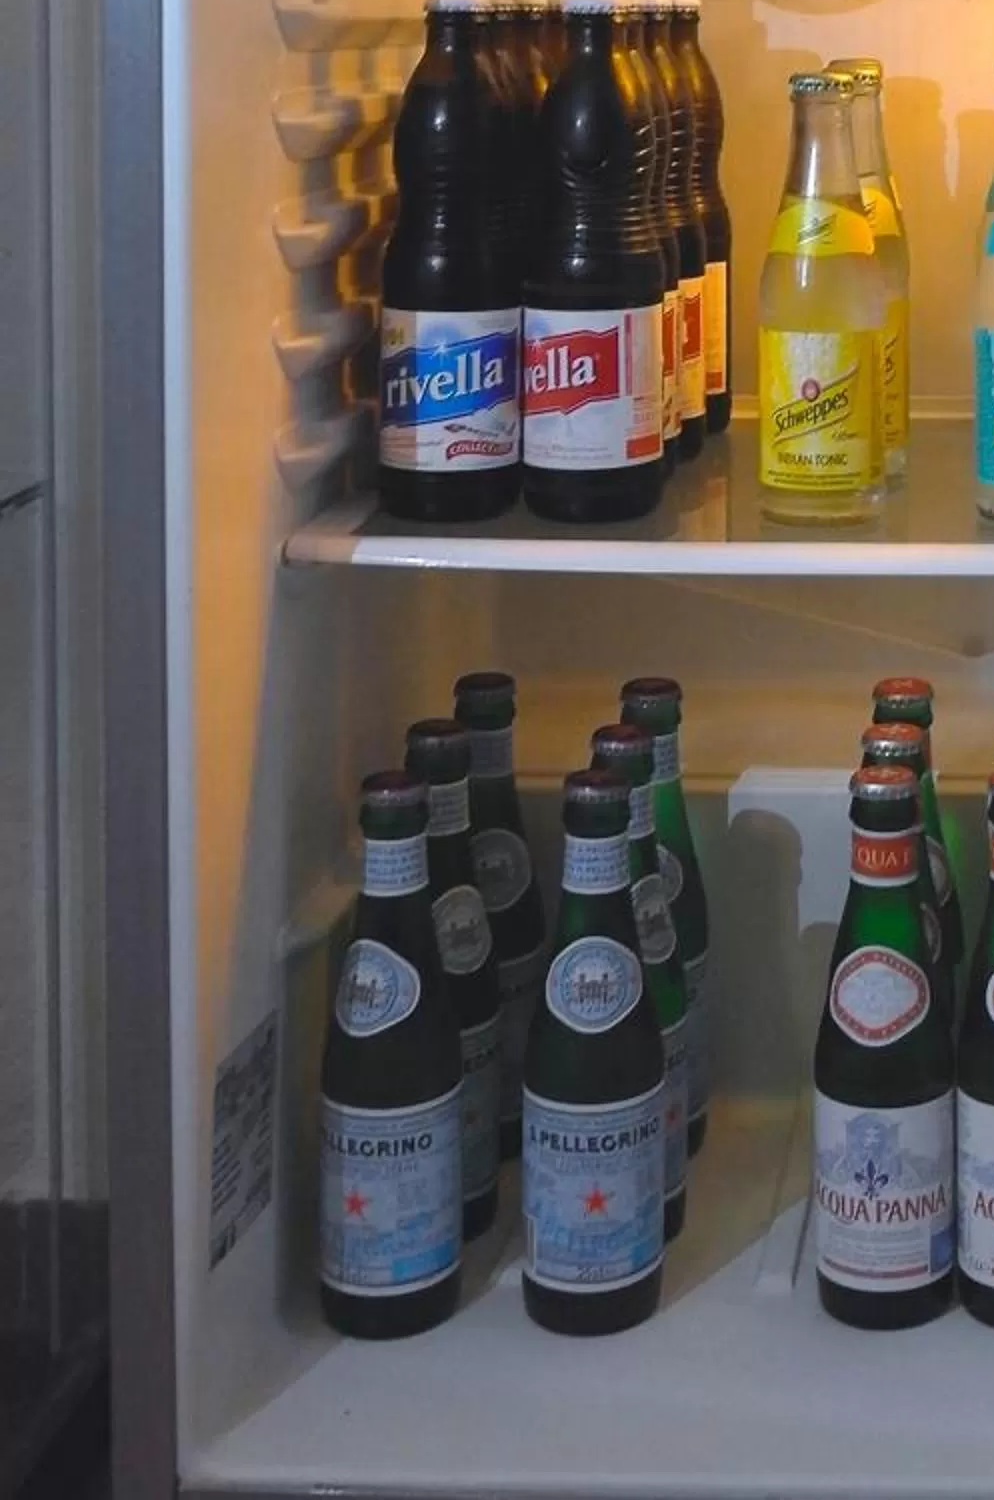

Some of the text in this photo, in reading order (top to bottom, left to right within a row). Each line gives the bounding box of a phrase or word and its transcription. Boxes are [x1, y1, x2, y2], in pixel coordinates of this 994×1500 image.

[387, 349, 504, 409] rivella
[524, 345, 598, 396] ella
[775, 387, 849, 433] Schweppes
[857, 847, 898, 869] QUA
[876, 1182, 947, 1223] PANNA
